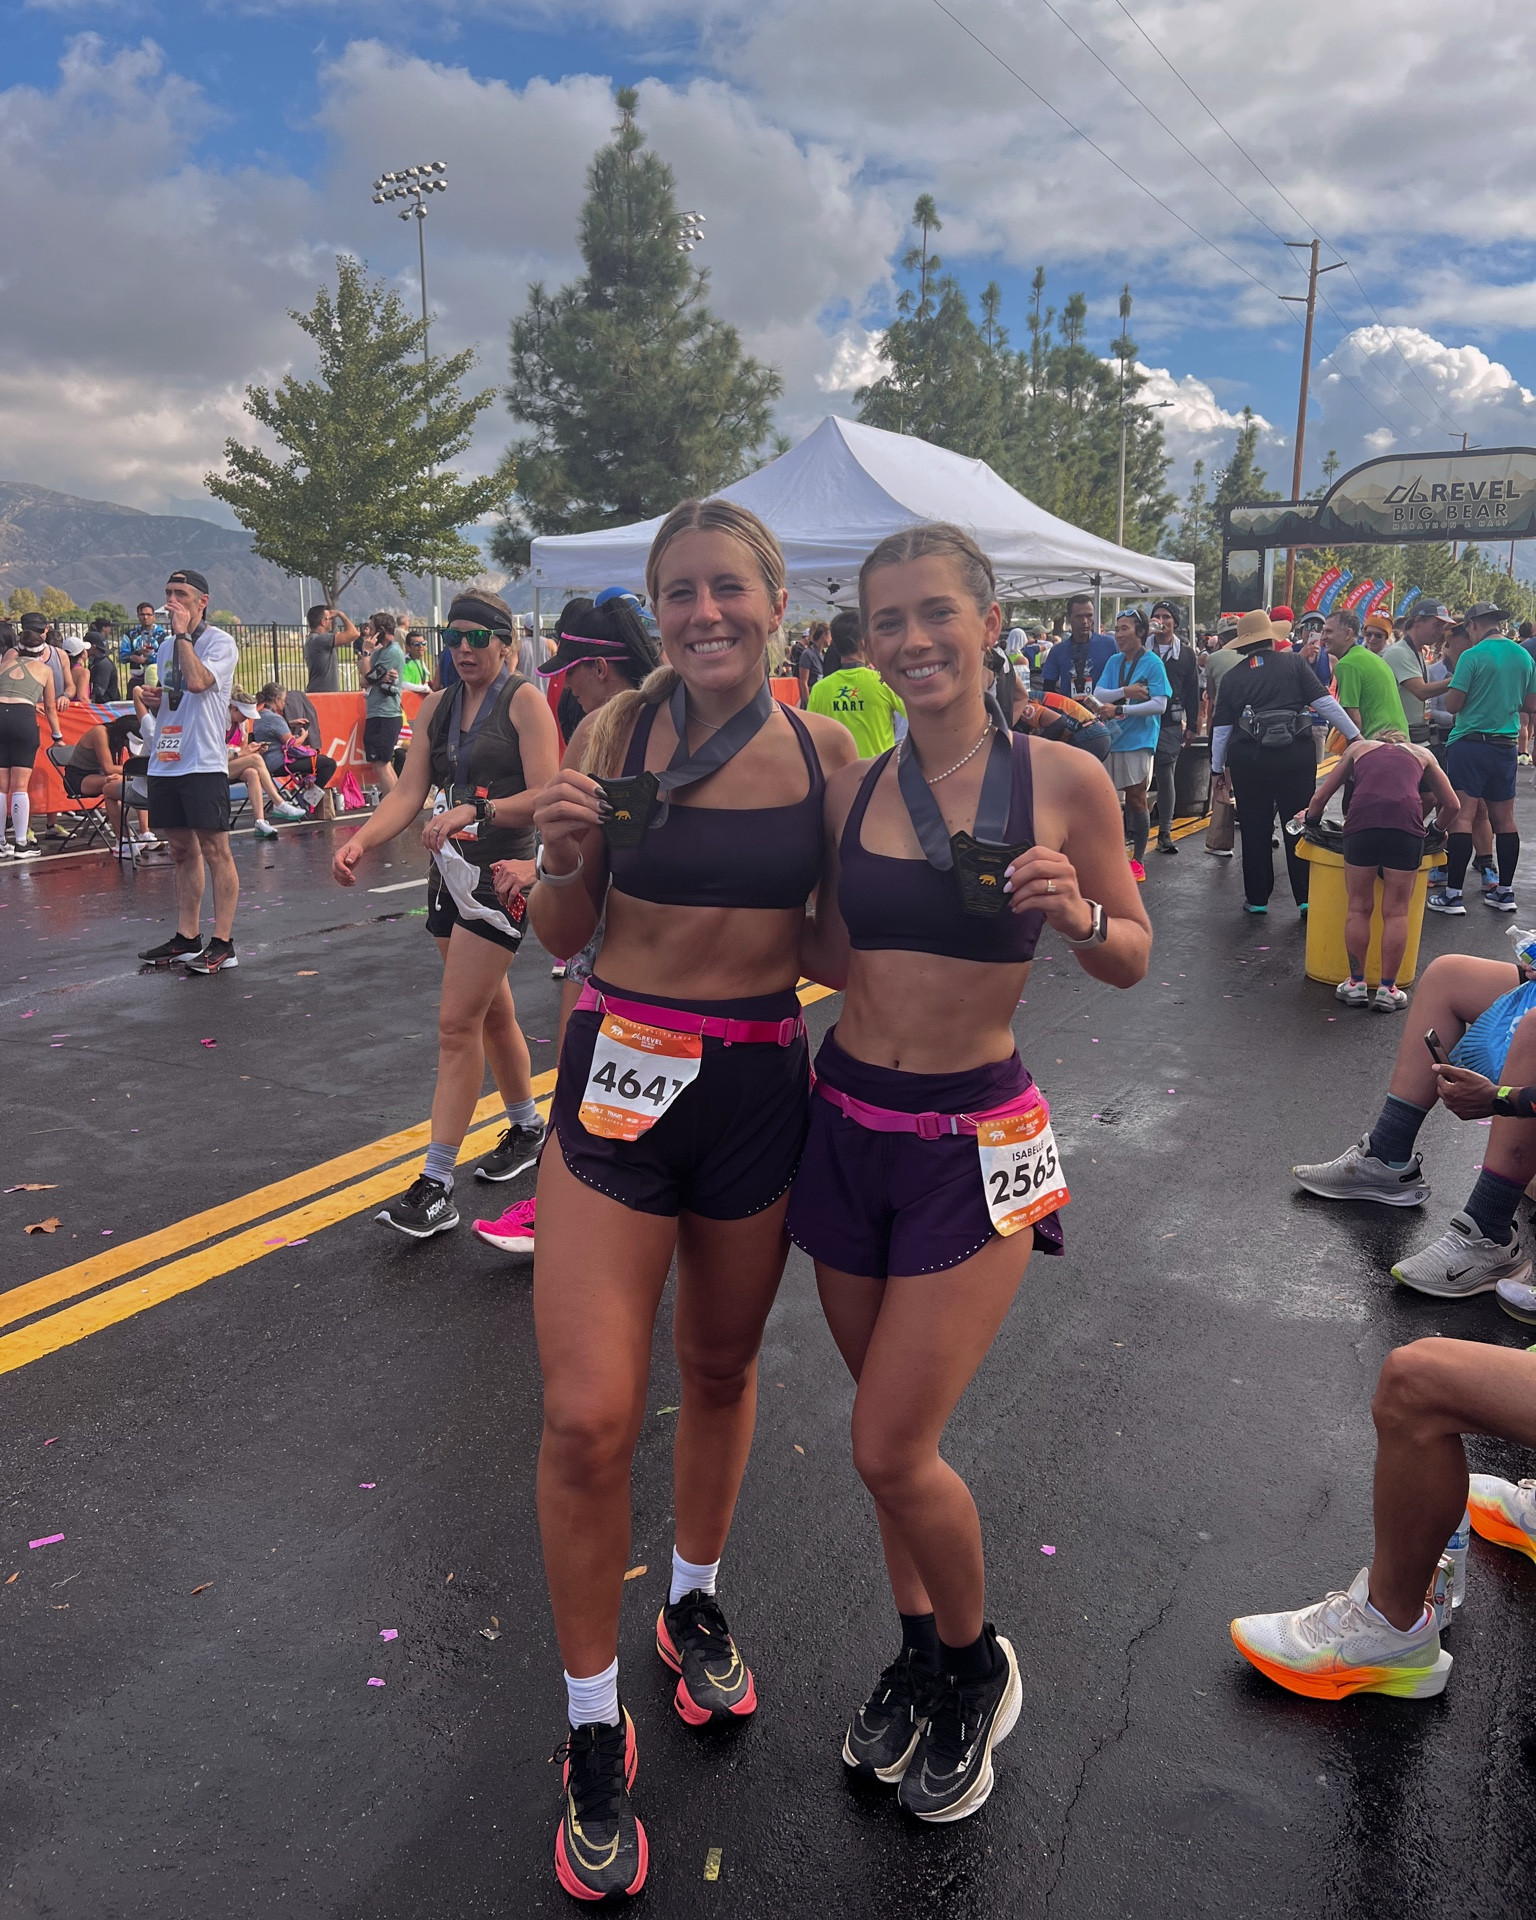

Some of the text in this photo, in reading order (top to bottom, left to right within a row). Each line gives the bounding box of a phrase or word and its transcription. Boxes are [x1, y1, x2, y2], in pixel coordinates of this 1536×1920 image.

[1431, 479, 1520, 503] REVEL
[1393, 503, 1508, 521] BIG BEAR
[1392, 522, 1457, 531] MARATHON
[1478, 519, 1509, 528] HALF
[1315, 572, 1337, 594] REVEL
[1329, 574, 1349, 595] REVEL
[1352, 583, 1371, 599] REVEL
[1403, 589, 1418, 605] REVEL
[641, 1036, 663, 1046] REVEL
[1012, 1139, 1044, 1162] ISABELLE
[990, 1144, 1057, 1206] 2565
[426, 1196, 447, 1221] HOKA
